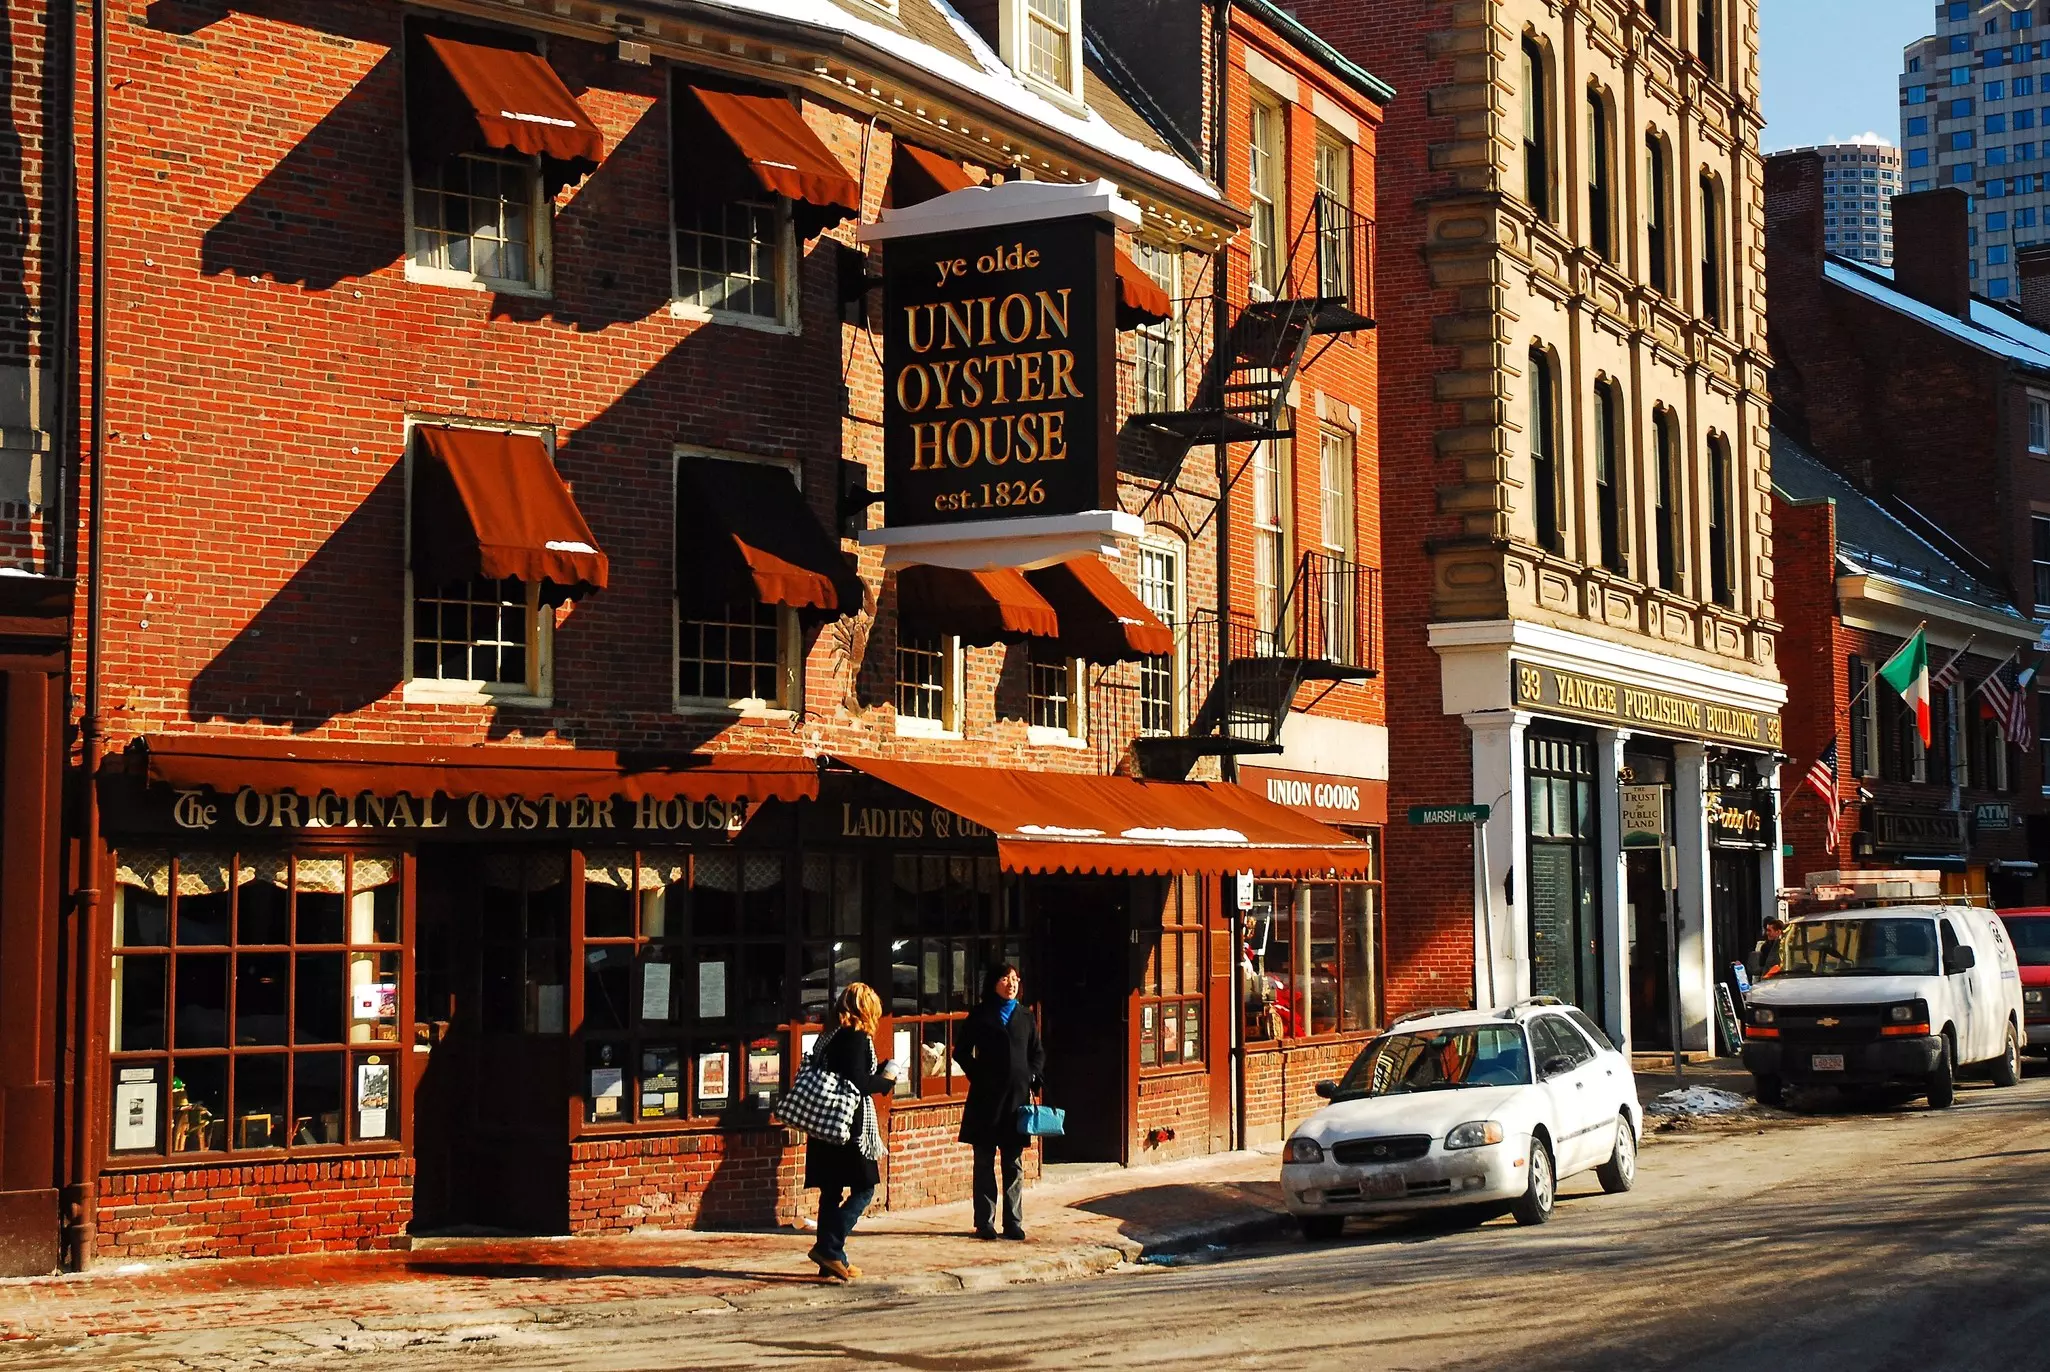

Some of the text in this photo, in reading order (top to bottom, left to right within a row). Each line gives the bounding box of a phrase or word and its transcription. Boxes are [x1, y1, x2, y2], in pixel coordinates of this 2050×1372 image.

[935, 242, 1041, 288] ye olde
[903, 288, 1073, 353] UNION
[896, 349, 1084, 413] OYSTER
[909, 410, 1067, 471] HOUSE
[1520, 667, 1780, 743] 33 YANKEE PUBLISHING BUILDING 33
[174, 788, 743, 831] The ORIGINAL OYSTER HOUSE
[1266, 778, 1360, 811] UNION GOODS
[1622, 792, 1656, 802] TRUST
[1976, 805, 2009, 819] ATM
[841, 803, 923, 838] LADIES
[931, 807, 950, 838] &
[1423, 810, 1477, 824] MARSH LANE
[1622, 810, 1658, 819] PUBLIC
[1627, 820, 1655, 828] LAND
